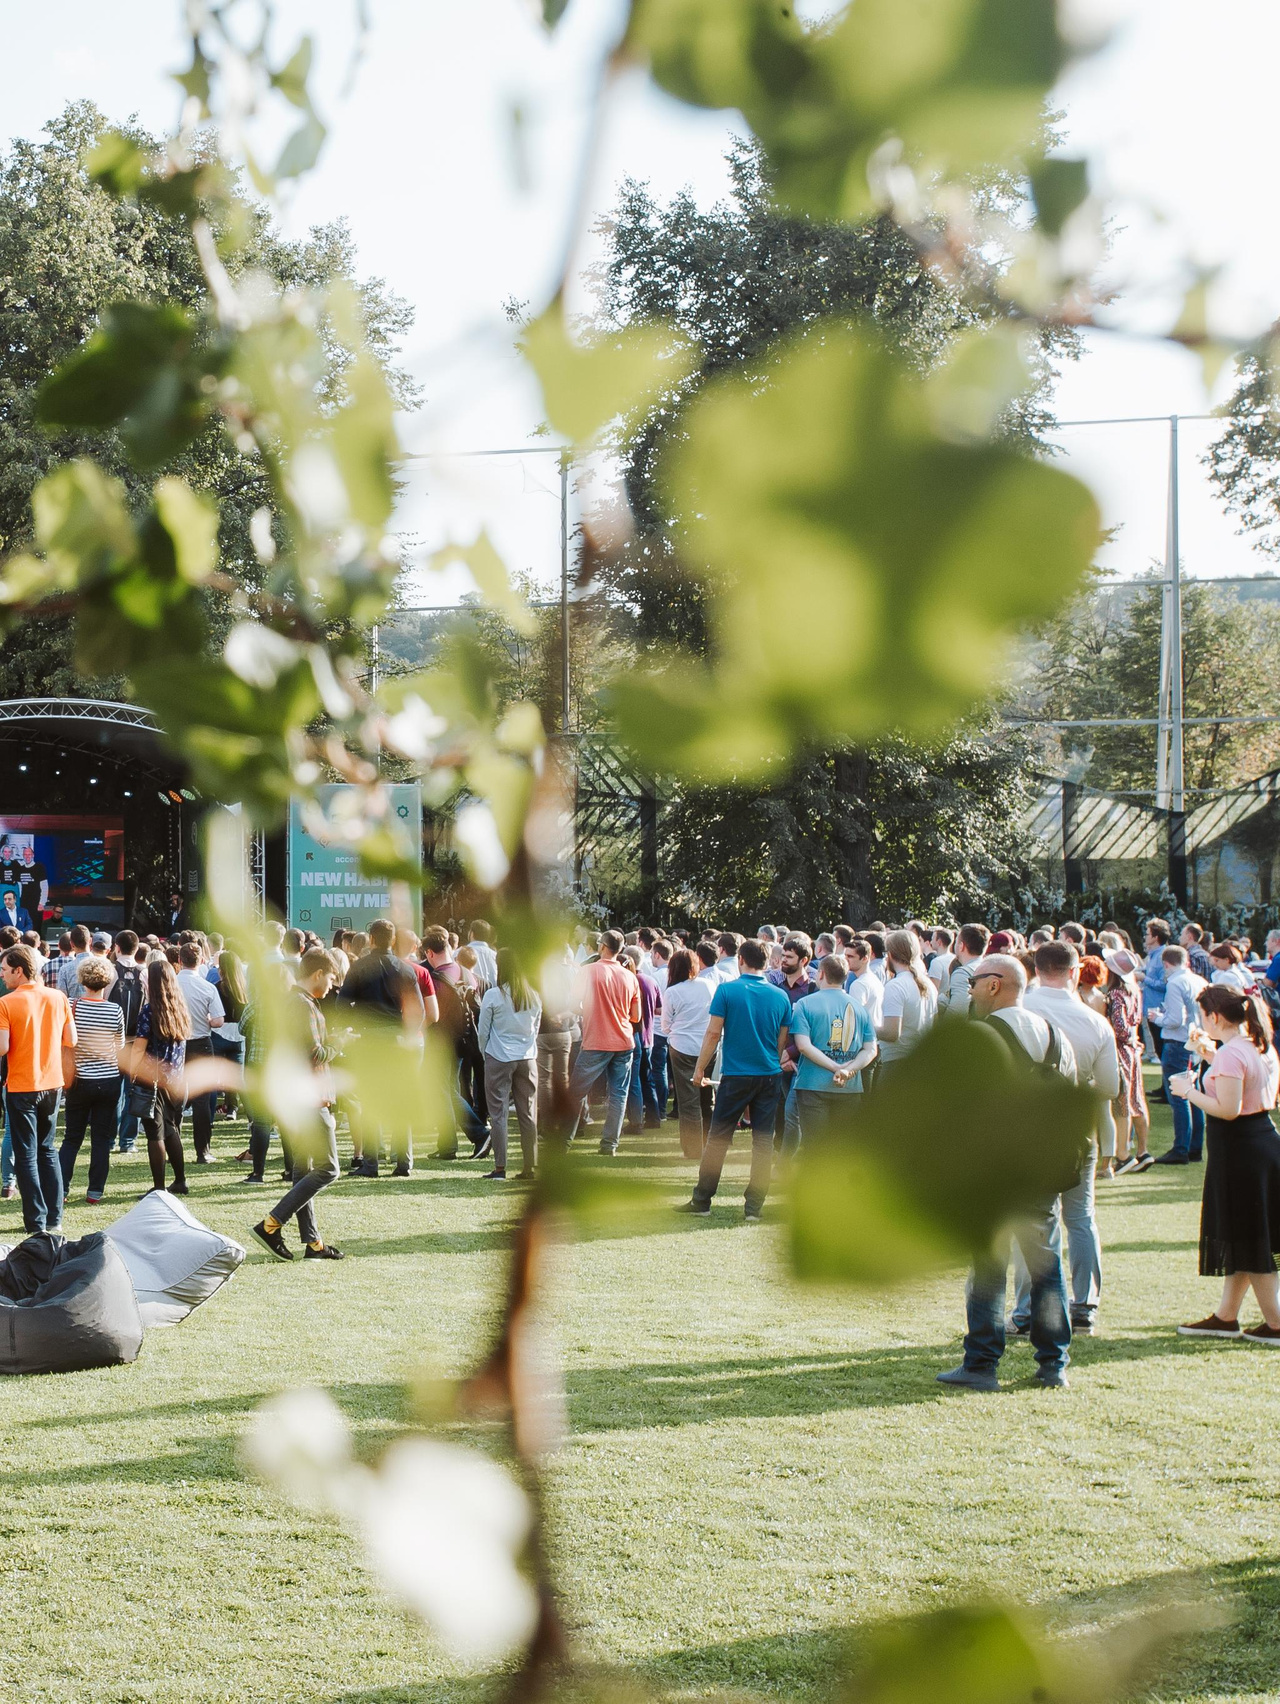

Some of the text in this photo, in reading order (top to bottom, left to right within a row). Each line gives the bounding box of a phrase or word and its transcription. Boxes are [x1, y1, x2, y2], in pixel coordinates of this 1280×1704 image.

[300, 871, 388, 886] NEW HABI
[320, 893, 391, 908] NEW ME
